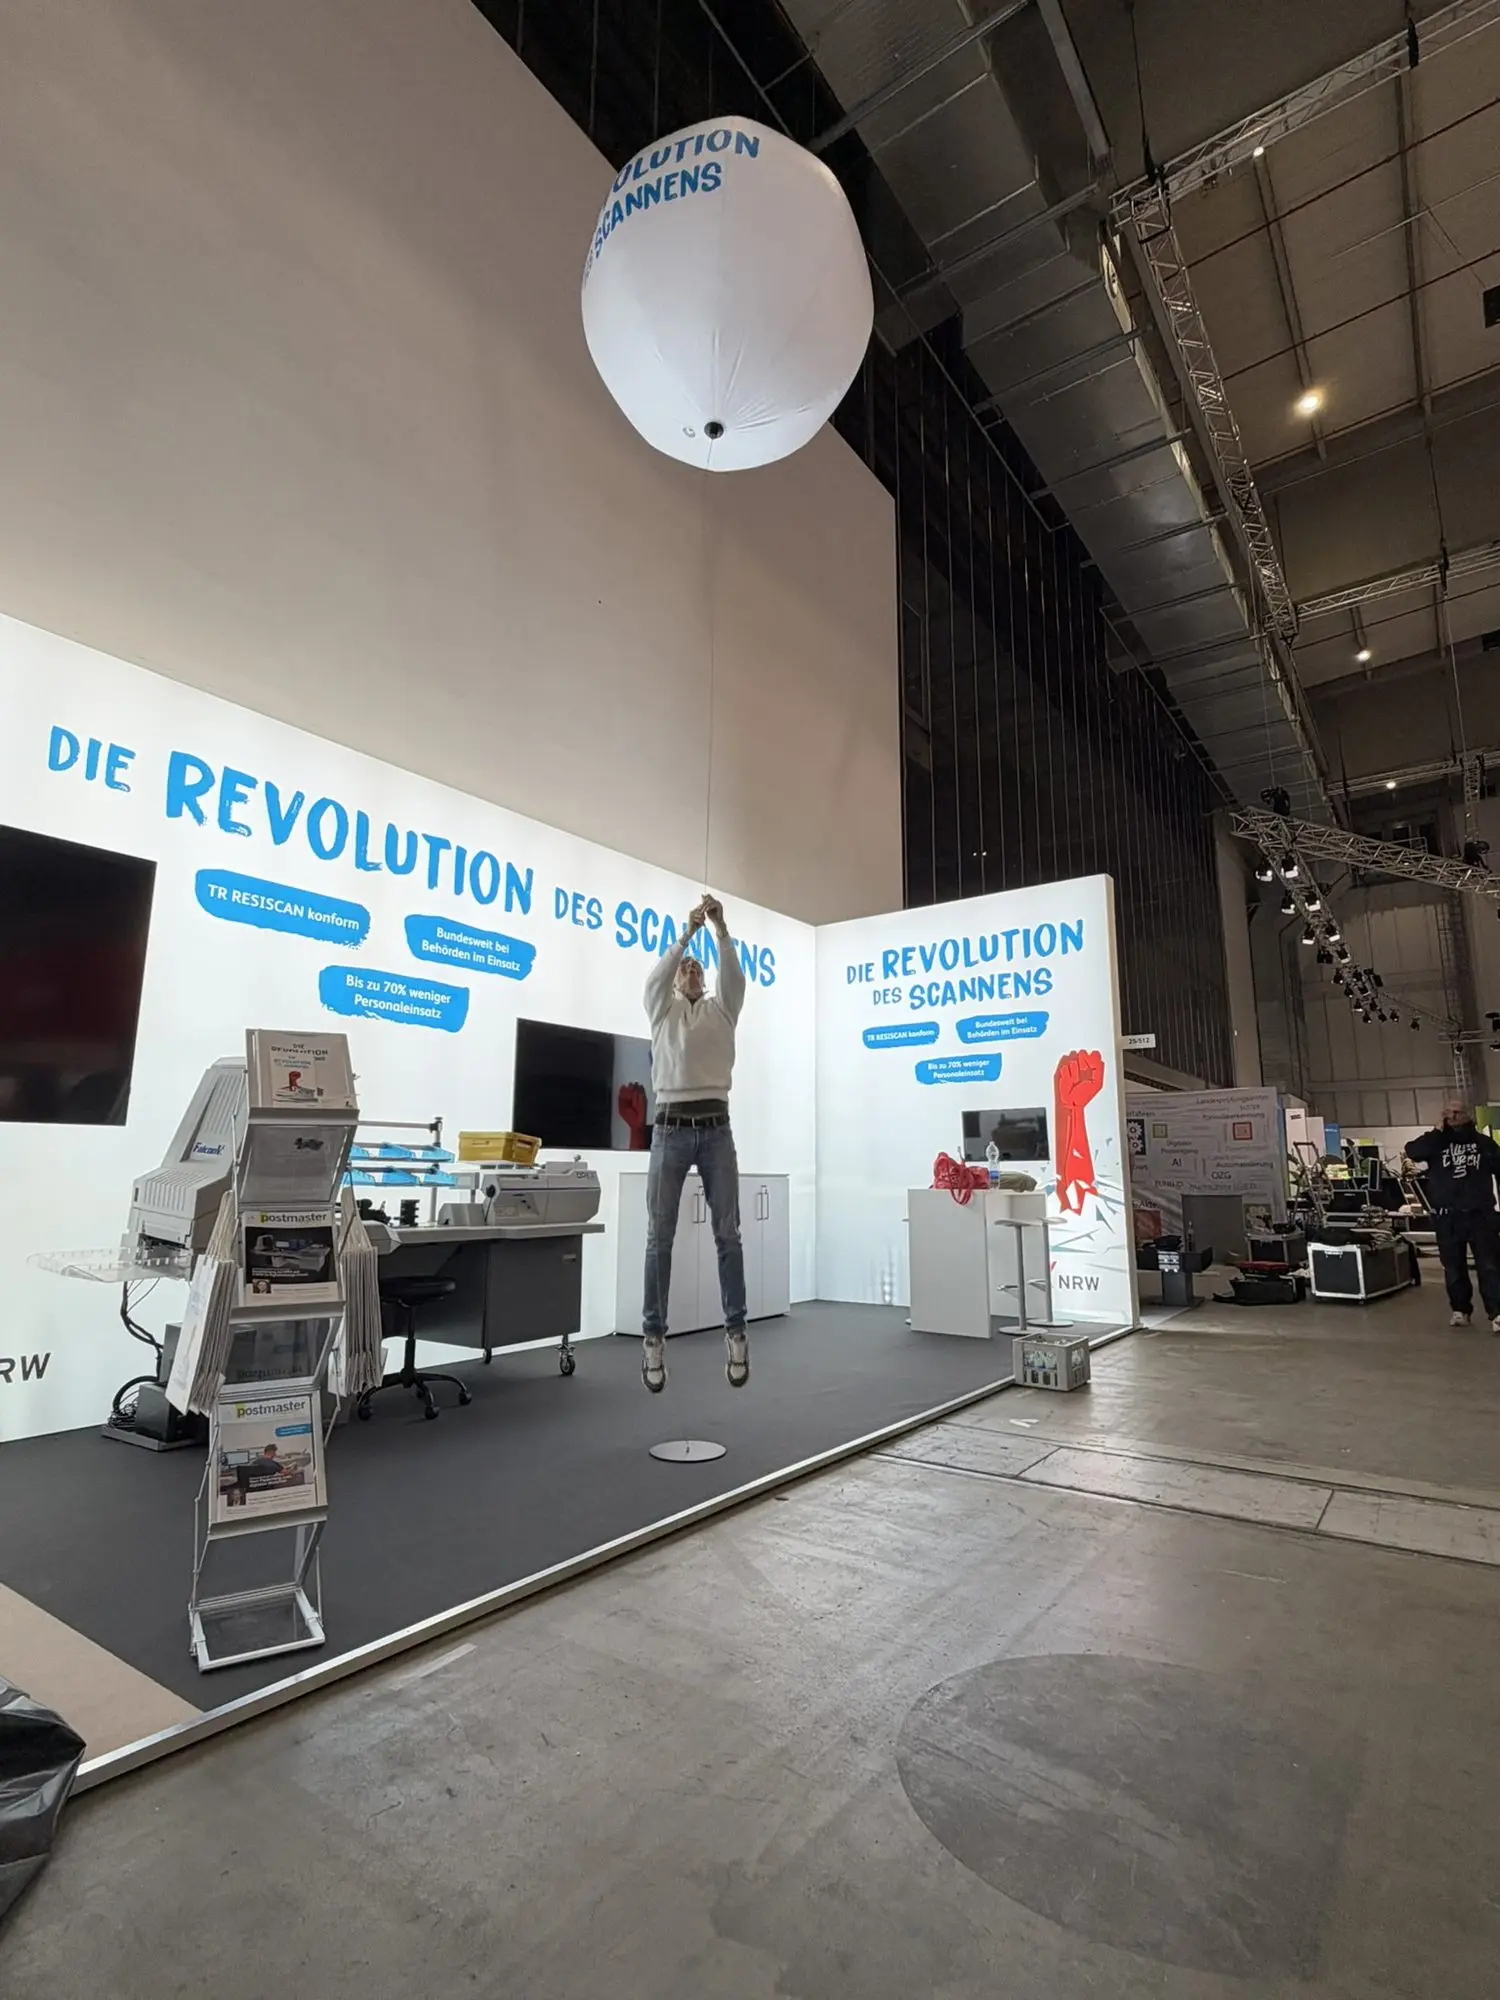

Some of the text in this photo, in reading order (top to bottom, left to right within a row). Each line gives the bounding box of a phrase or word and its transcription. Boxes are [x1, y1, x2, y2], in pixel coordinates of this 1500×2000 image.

[594, 161, 722, 259] SCANNENS
[48, 725, 136, 793] DIE
[165, 750, 534, 915] REVOLUTION
[555, 886, 603, 930] DES
[208, 884, 360, 931] TR RESISCAN konform
[436, 926, 510, 954] Bundesweit bei
[846, 918, 1084, 985] DIE REVOLUTION
[421, 939, 521, 973] Behörden im Einsatz
[345, 974, 452, 1005] Bis zu 70% weniger
[873, 967, 1054, 1011] DES SCANNENS
[354, 994, 442, 1020] Personaleinsatz
[975, 1018, 1015, 1029] Bundesweit
[1011, 1025, 1038, 1035] Einsatz
[261, 1213, 327, 1224] postmaster
[1058, 1274, 1100, 1292] NRW
[0, 1352, 51, 1384] RW
[237, 1400, 306, 1419] postmaster
